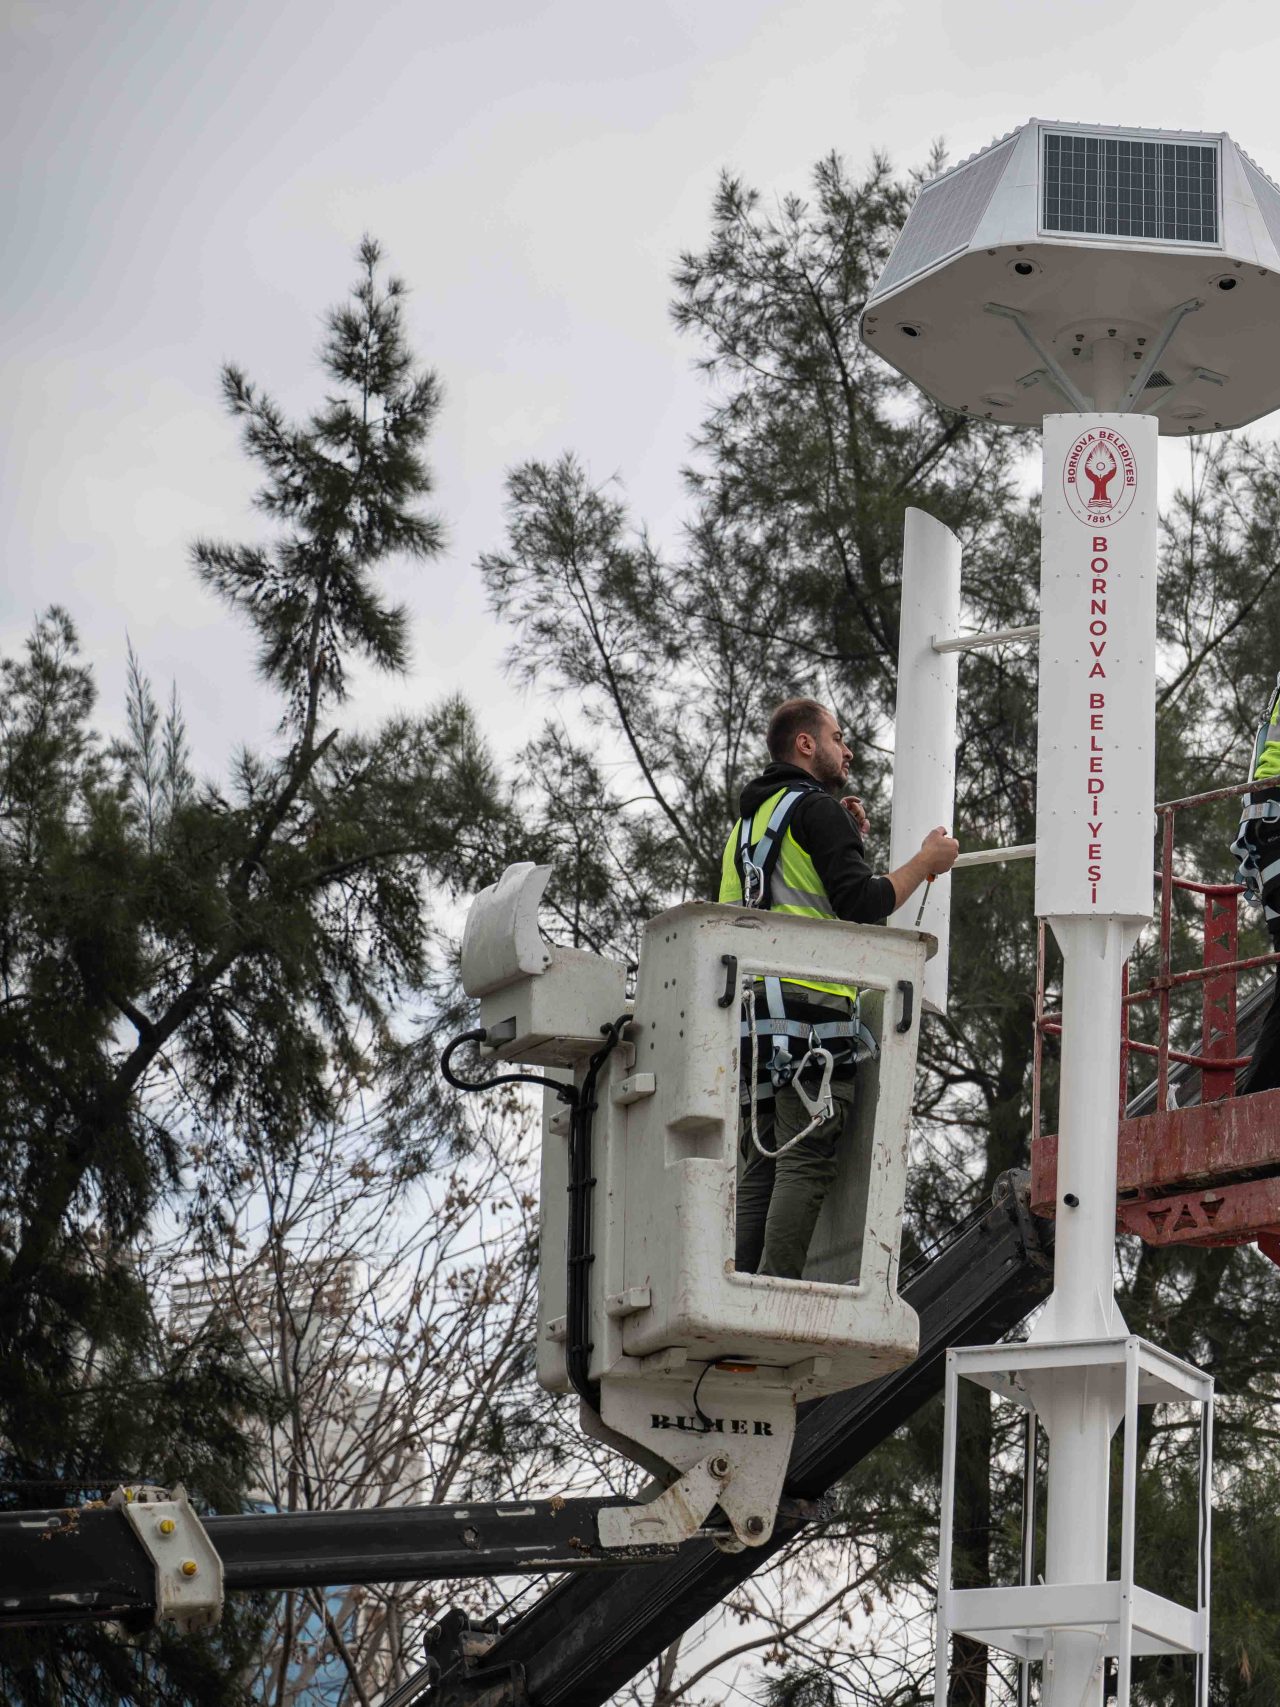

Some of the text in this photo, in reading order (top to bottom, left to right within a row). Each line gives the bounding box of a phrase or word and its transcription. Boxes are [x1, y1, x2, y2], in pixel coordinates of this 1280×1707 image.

[1067, 430, 1137, 487] BORNOVA BELEDİYESİ
[1087, 514, 1112, 523] 1881
[1086, 536, 1108, 904] BORNOVA BELEDİYESİ
